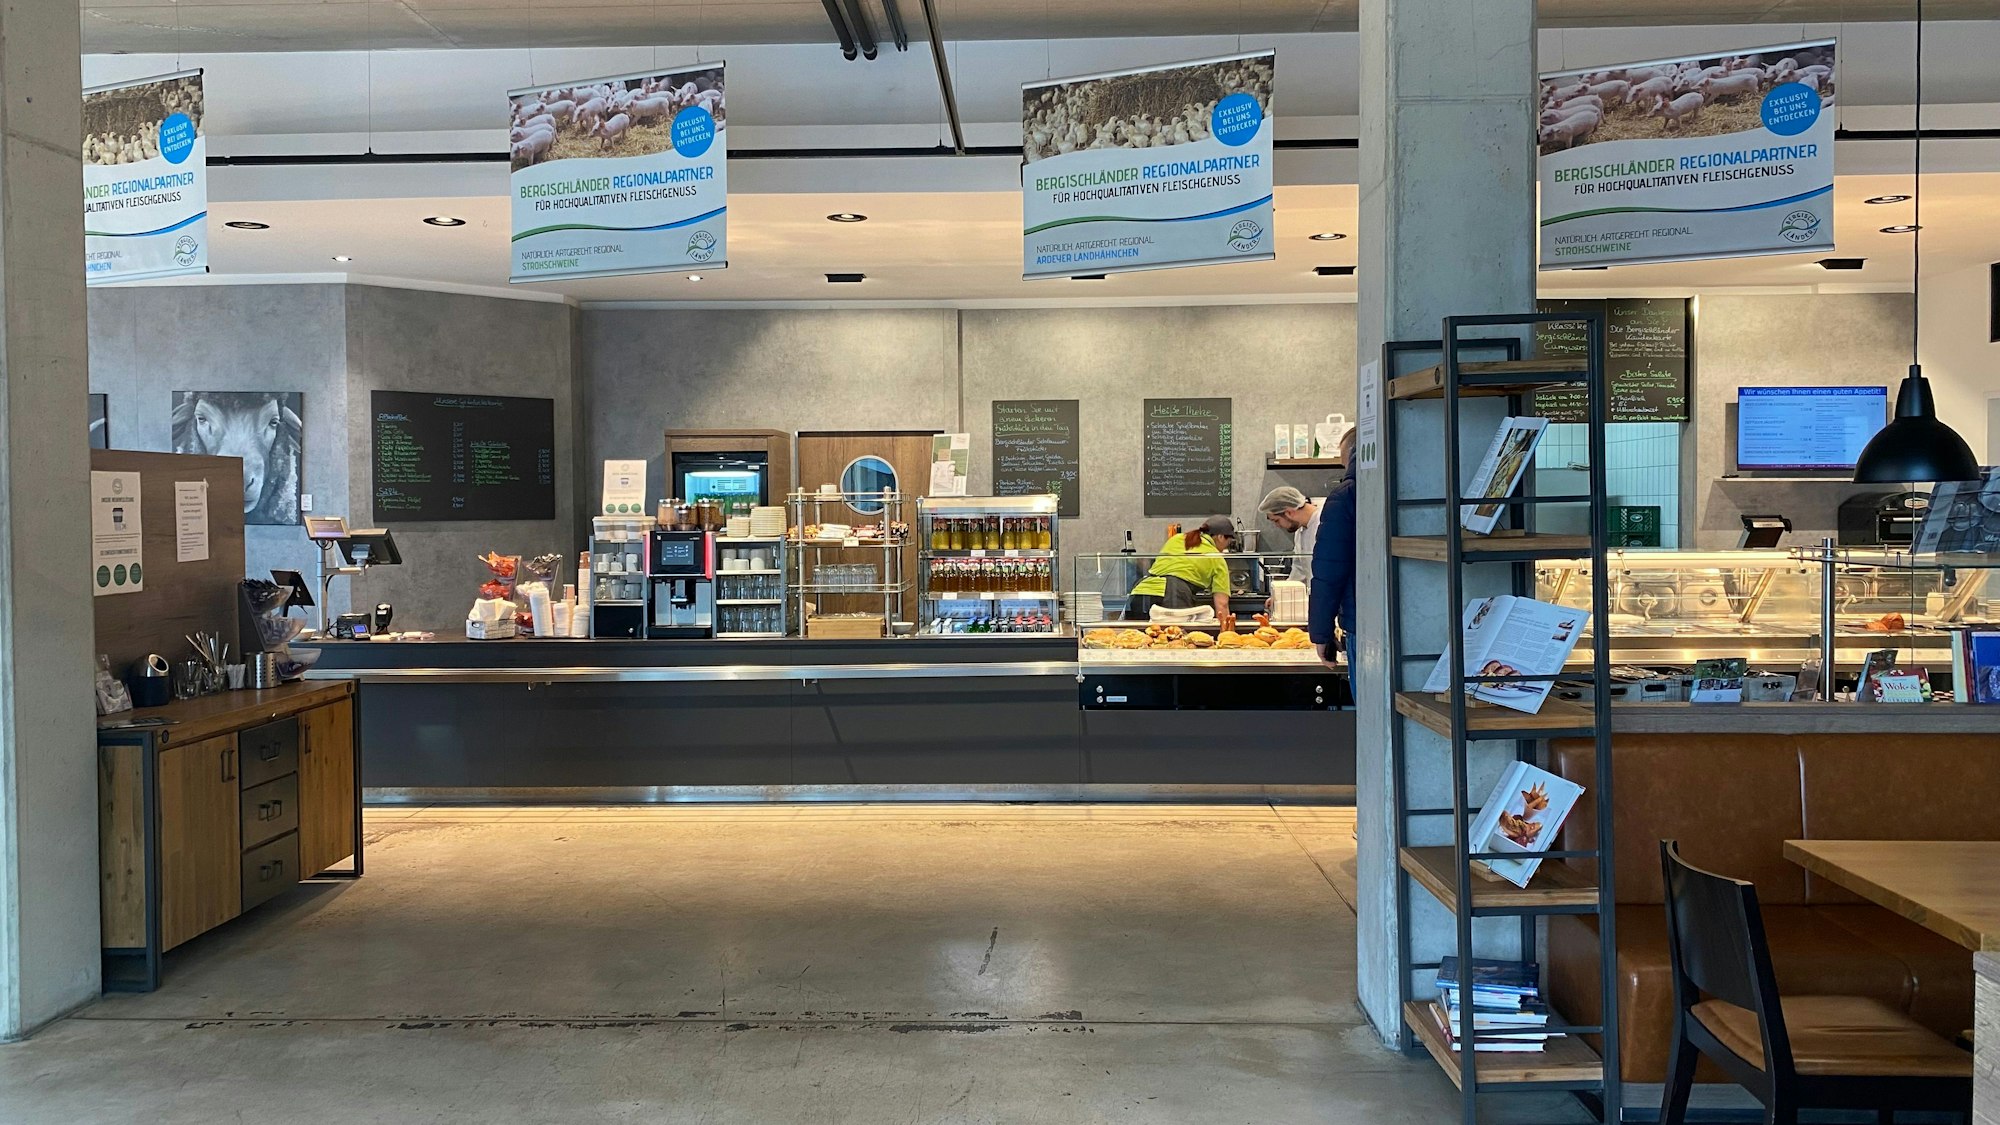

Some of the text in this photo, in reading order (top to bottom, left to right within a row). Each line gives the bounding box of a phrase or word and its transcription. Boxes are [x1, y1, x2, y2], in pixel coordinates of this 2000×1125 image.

[1769, 91, 1809, 108] EXKLUSIV
[1218, 102, 1252, 118] EXKLUSIV
[1773, 102, 1807, 115] BEI UNS
[676, 115, 706, 129] EXKLUSIV
[1222, 113, 1251, 126] BEI UNS
[1768, 109, 1815, 125] ENTDECKEN
[164, 124, 187, 137] EXKLUSIV
[680, 124, 705, 137] BEI UNS
[1218, 119, 1258, 136] ENTDECKEN
[167, 132, 187, 144] BEI UNS
[677, 132, 711, 148] ENTDECKEN
[164, 139, 192, 154] ENTDECKEN
[1554, 144, 1817, 183] BERGISCHLÄNDER REGIONALPARTNER
[1036, 154, 1260, 191] BERGISCHLÄNDER REGIONALPARTNER
[1574, 164, 1794, 195] FÜR HOCHQUALITATIVEN FLEISCHGENUSS
[112, 172, 193, 195] REGIONALPARTNER
[520, 166, 713, 198] BERGISCHLÄNDER REGIONALPARTNER
[1053, 174, 1241, 204] FÜR HOCHQUALITATIVEN FLEISCHGENUSS
[126, 192, 181, 208] FLEISCHGENUSS
[536, 186, 697, 211] FÜR HOCHQUALITATIVEN FLEISCHGENUSS
[1786, 213, 1814, 224] BERGISCH
[1036, 248, 1139, 264] ARDEYER LANDHÄHNCHEN
[1555, 242, 1631, 256] STROHSCHWEINE
[522, 259, 579, 270] STROHSCHWEINE
[1610, 325, 1680, 335] Die Bergischländer
[997, 403, 1060, 413] Starten Sie mit
[1154, 405, 1211, 417] Heiße Theke
